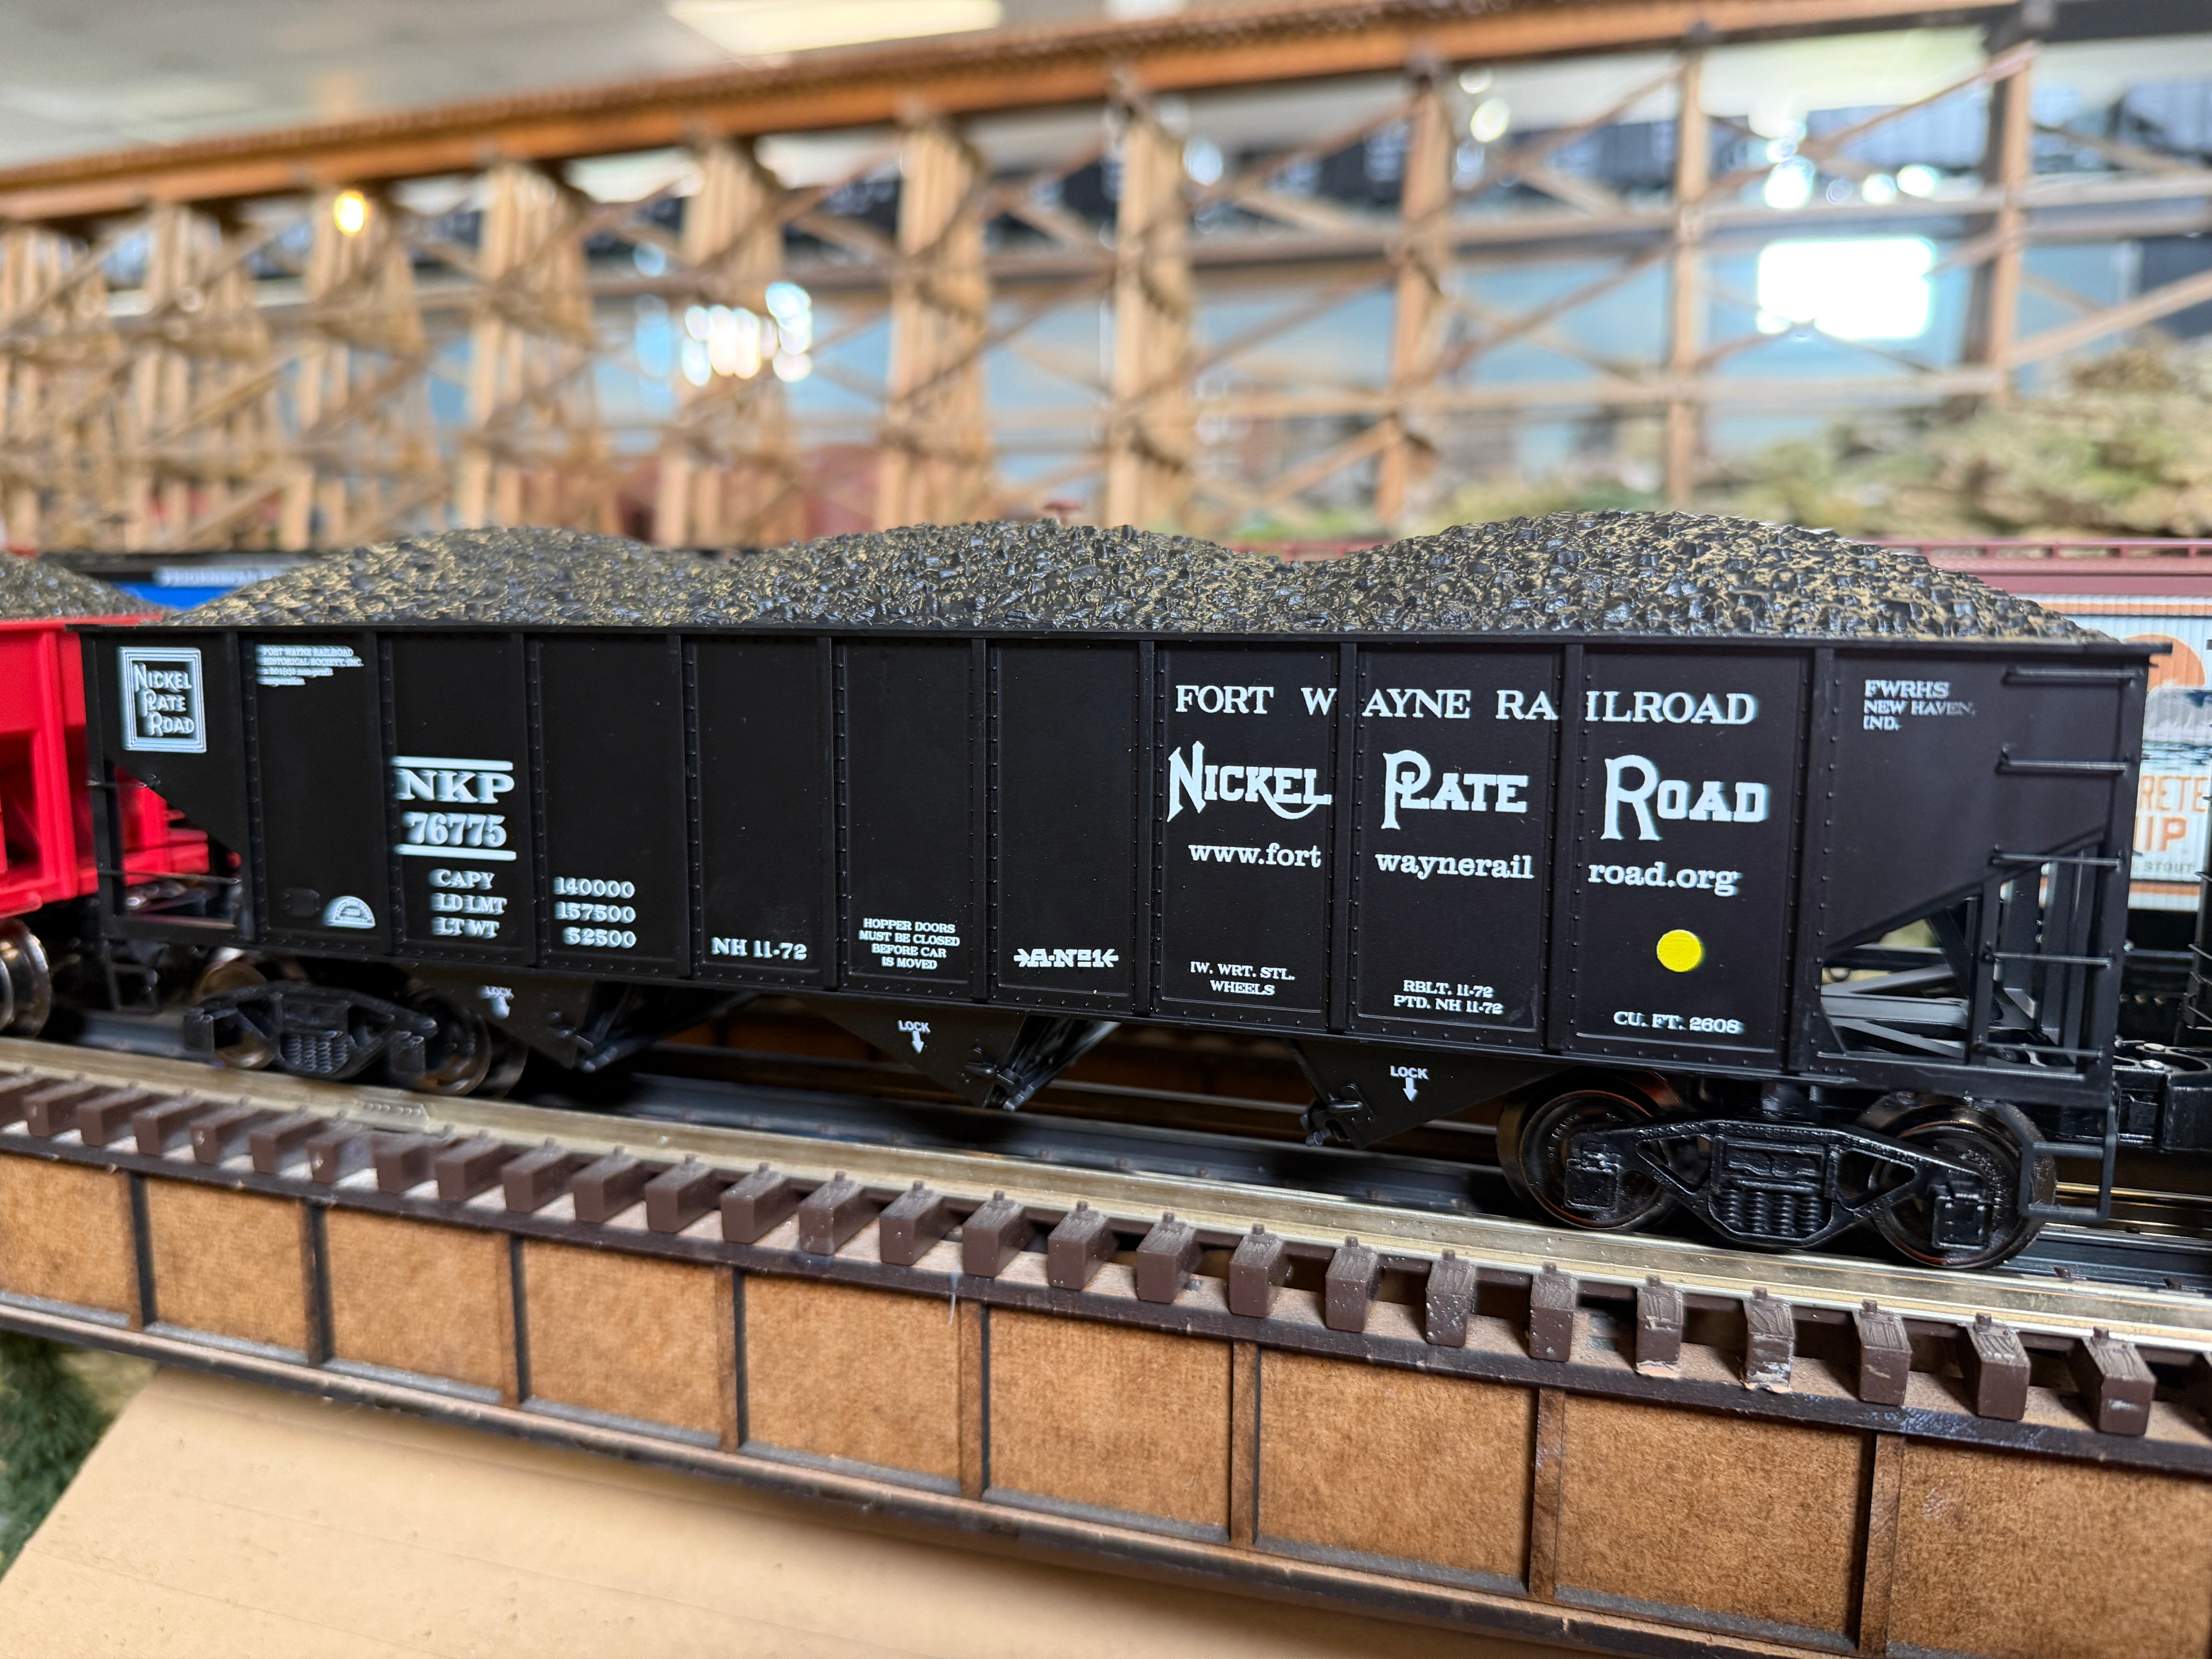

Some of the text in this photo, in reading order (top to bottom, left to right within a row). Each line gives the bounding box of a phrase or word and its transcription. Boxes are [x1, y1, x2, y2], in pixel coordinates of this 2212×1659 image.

[263, 646, 354, 657] FORT WAYNE RAILROAD
[263, 657, 309, 665] HISTORICAL
[1865, 679, 1949, 698] FWRHS
[137, 689, 187, 717] PLATE
[1176, 685, 1274, 714] FORT
[1864, 699, 1908, 715] NEW
[143, 711, 194, 737] ROAD
[393, 769, 514, 804] NKP
[1167, 741, 1768, 841] NICKEL PLATE ROAD
[402, 812, 507, 847] 76775
[1188, 843, 1741, 896] www.fort waynerail road.org
[430, 869, 495, 890] CAPY
[554, 877, 635, 898] 140000
[431, 893, 507, 915] LD LMT
[555, 902, 636, 923] 157500
[432, 917, 500, 939] LT WT
[863, 918, 955, 933] HOPPER DOORS
[563, 927, 636, 948] 52500
[859, 930, 960, 946] MUST BE CLOSED
[712, 938, 747, 956] NH
[872, 943, 946, 958] BEFORE CAR
[881, 957, 937, 970] IS MOVED
[1218, 963, 1256, 977] WRT.
[1260, 967, 1295, 980] STL.
[479, 986, 514, 1000] LOCK
[1210, 980, 1275, 995] WHEELS
[1403, 980, 1452, 995] RBLT.
[1394, 995, 1431, 1009] PTD.
[1435, 998, 1462, 1012] NH
[898, 1020, 930, 1033] LOCK
[1614, 1012, 1743, 1034] CU. FT. 2608
[1391, 1066, 1428, 1079] LOCK
